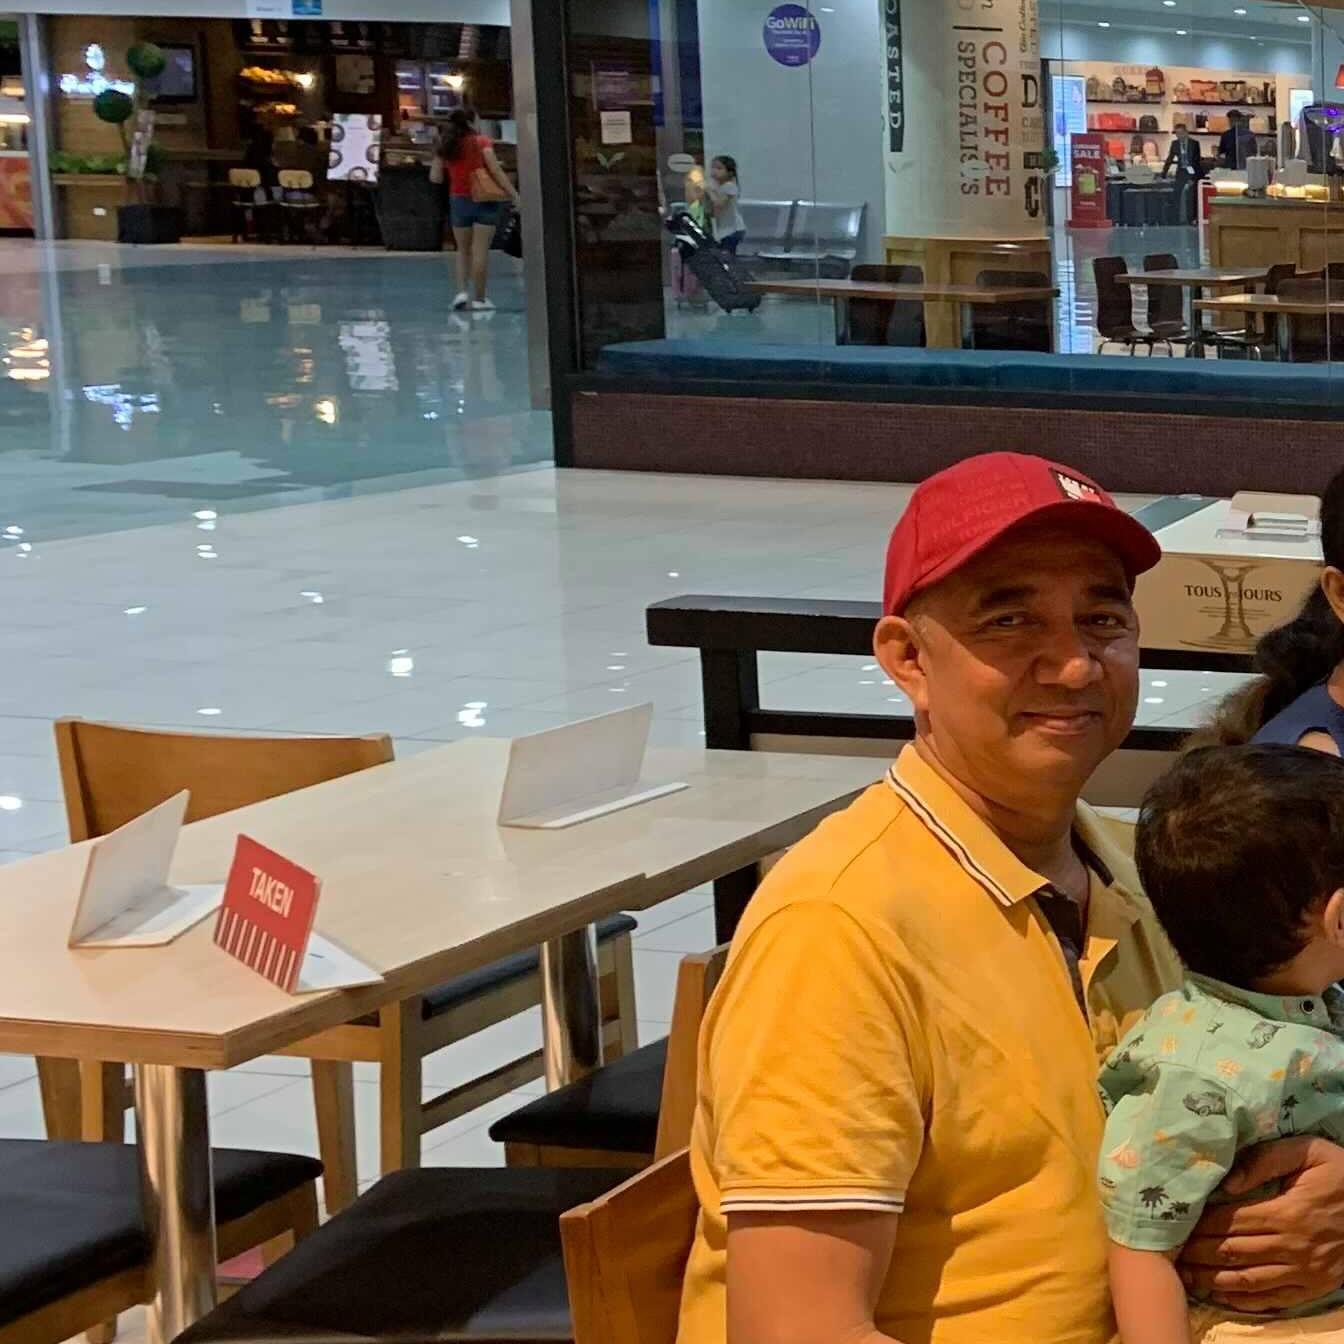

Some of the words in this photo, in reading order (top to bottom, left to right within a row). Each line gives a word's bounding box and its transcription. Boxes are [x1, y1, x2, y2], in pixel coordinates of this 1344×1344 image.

[957, 41, 980, 196] SPECIALISS
[982, 41, 1011, 196] COFFEE
[1184, 585, 1222, 598] TOUS
[249, 866, 294, 918] TAKEN
